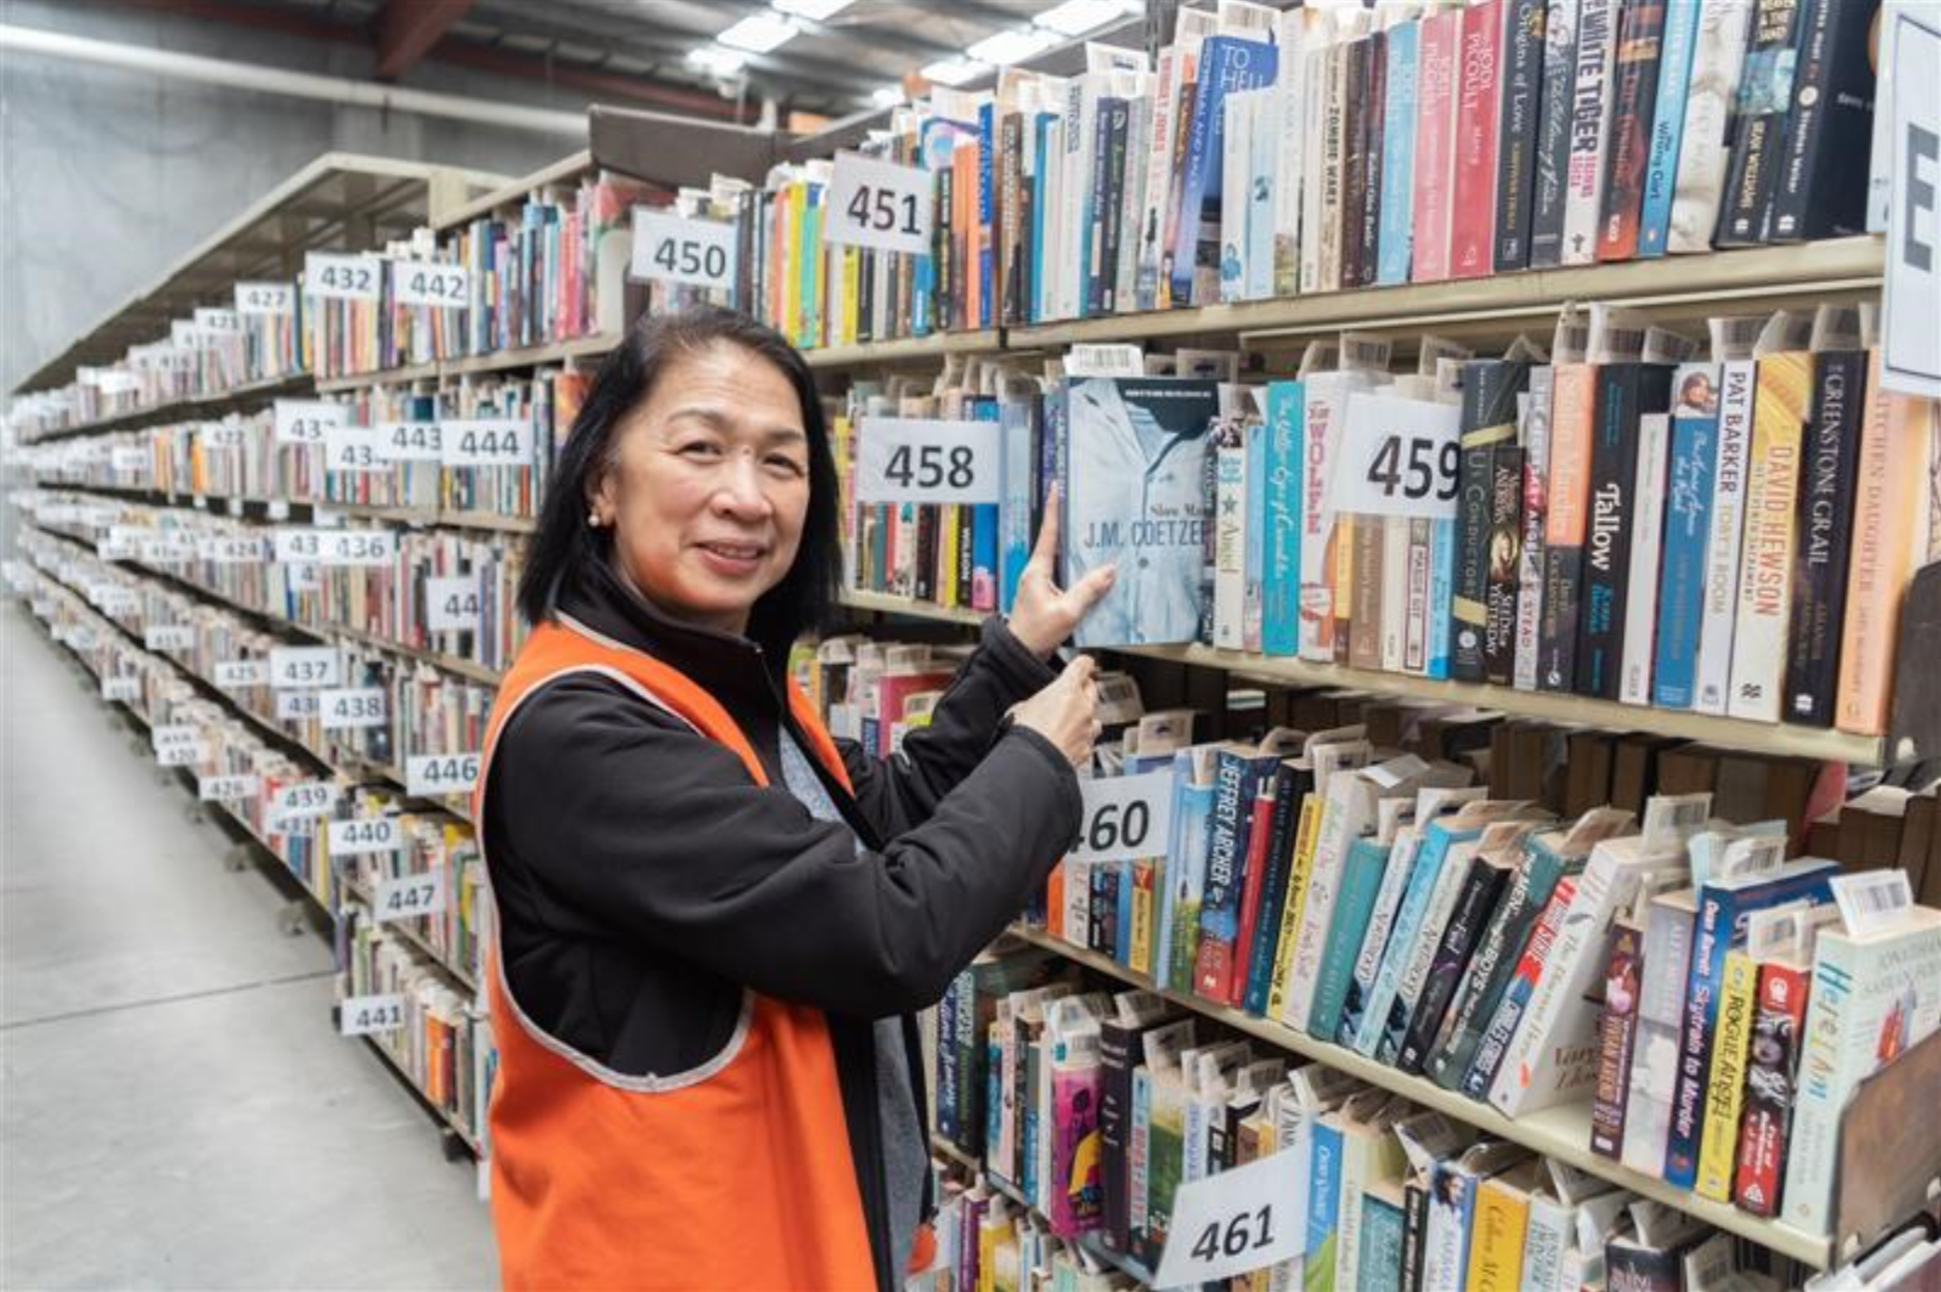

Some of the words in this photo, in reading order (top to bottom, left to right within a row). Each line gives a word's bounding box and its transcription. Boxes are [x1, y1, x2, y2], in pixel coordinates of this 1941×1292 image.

[1223, 44, 1249, 69] TO
[1511, 0, 1535, 69] Origins
[1577, 8, 1611, 78] WHITE
[1462, 32, 1479, 110] PICOULT
[1477, 41, 1494, 91] JODI
[1512, 73, 1528, 86] of
[1510, 93, 1526, 133] Love
[1571, 78, 1605, 155] TIGER
[1651, 121, 1670, 166] Wrong
[1649, 169, 1664, 200] Girl
[1904, 122, 1939, 272] E
[847, 185, 922, 235] 451
[322, 267, 371, 291] 432
[654, 238, 726, 278] 450
[411, 273, 463, 299] 442
[1725, 370, 1746, 406] PAT
[290, 419, 334, 438] 43
[391, 428, 441, 449] 443
[460, 430, 519, 456] 444
[1817, 375, 1844, 495] GREENSTONE
[1868, 392, 1894, 479] ITCHEN
[885, 445, 974, 488] 458
[1367, 436, 1461, 499] 459
[1717, 413, 1742, 493] BARKER
[1764, 445, 1793, 514] DAVID
[337, 537, 384, 557] 436
[1131, 519, 1205, 546] COETZE
[1218, 520, 1241, 574] Angel
[1588, 481, 1622, 571] Tallow
[1807, 498, 1834, 568] GRAIL
[1754, 523, 1789, 615] HEWSON
[1520, 600, 1533, 649] STEAD
[285, 661, 328, 680] 437
[335, 697, 381, 717] 438
[424, 759, 478, 782] 446
[1214, 757, 1243, 824] JEFFREY
[286, 788, 327, 803] 439
[343, 822, 390, 843] 440
[1069, 800, 1149, 854] 60
[1208, 823, 1235, 886] ARCHER
[388, 885, 435, 910] 447
[1470, 946, 1500, 992] BOYS
[357, 1006, 400, 1026] 441
[1683, 982, 1713, 1054] Skytrain
[1810, 961, 1854, 1038] Here
[1683, 1055, 1702, 1075] to
[1675, 1076, 1699, 1139] Murder
[1192, 1204, 1275, 1262] 461
